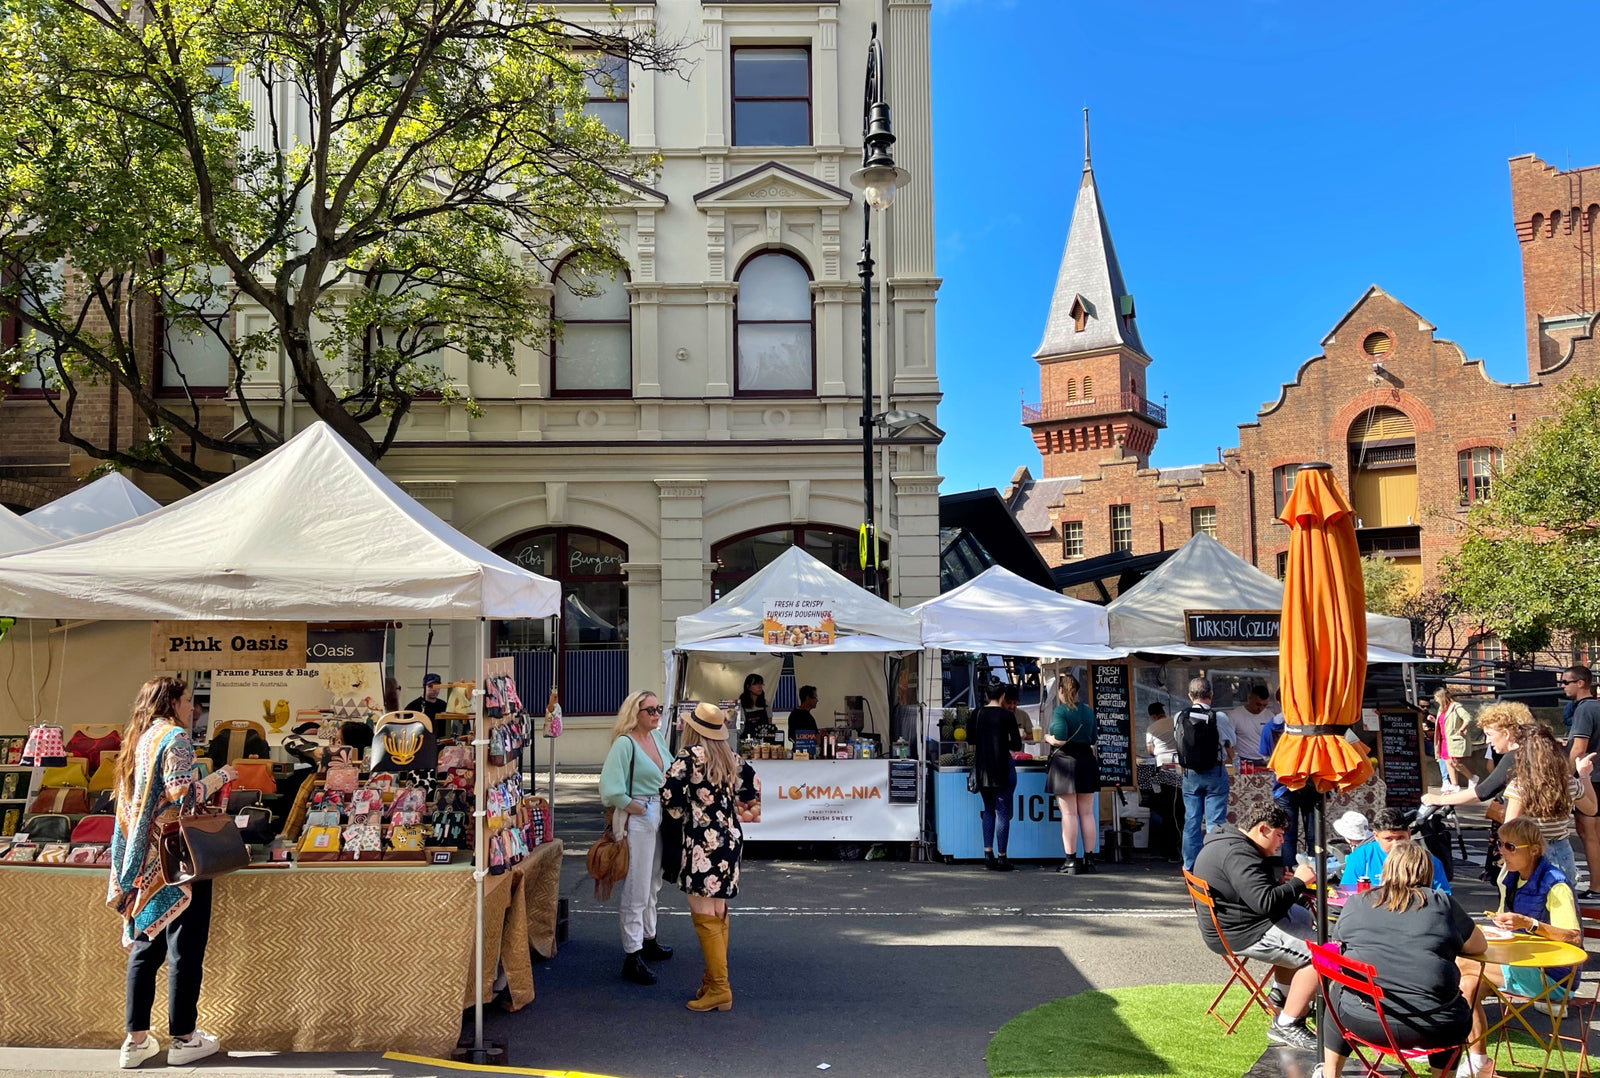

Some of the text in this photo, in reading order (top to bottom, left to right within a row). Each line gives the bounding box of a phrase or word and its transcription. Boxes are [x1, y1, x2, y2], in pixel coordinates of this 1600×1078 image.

[569, 550, 626, 574] Burgers
[774, 600, 793, 608] FRESH
[801, 600, 824, 608] CRISPY
[766, 610, 832, 618] TURKISH DOUGHNUTS
[1189, 615, 1237, 638] TURKISH
[169, 635, 288, 652] Pink Oasis
[216, 669, 319, 678] Frame Purses & Bags
[1097, 665, 1120, 676] FRESH
[1095, 674, 1119, 685] JUICE
[778, 785, 881, 800] LOKMA-NIA
